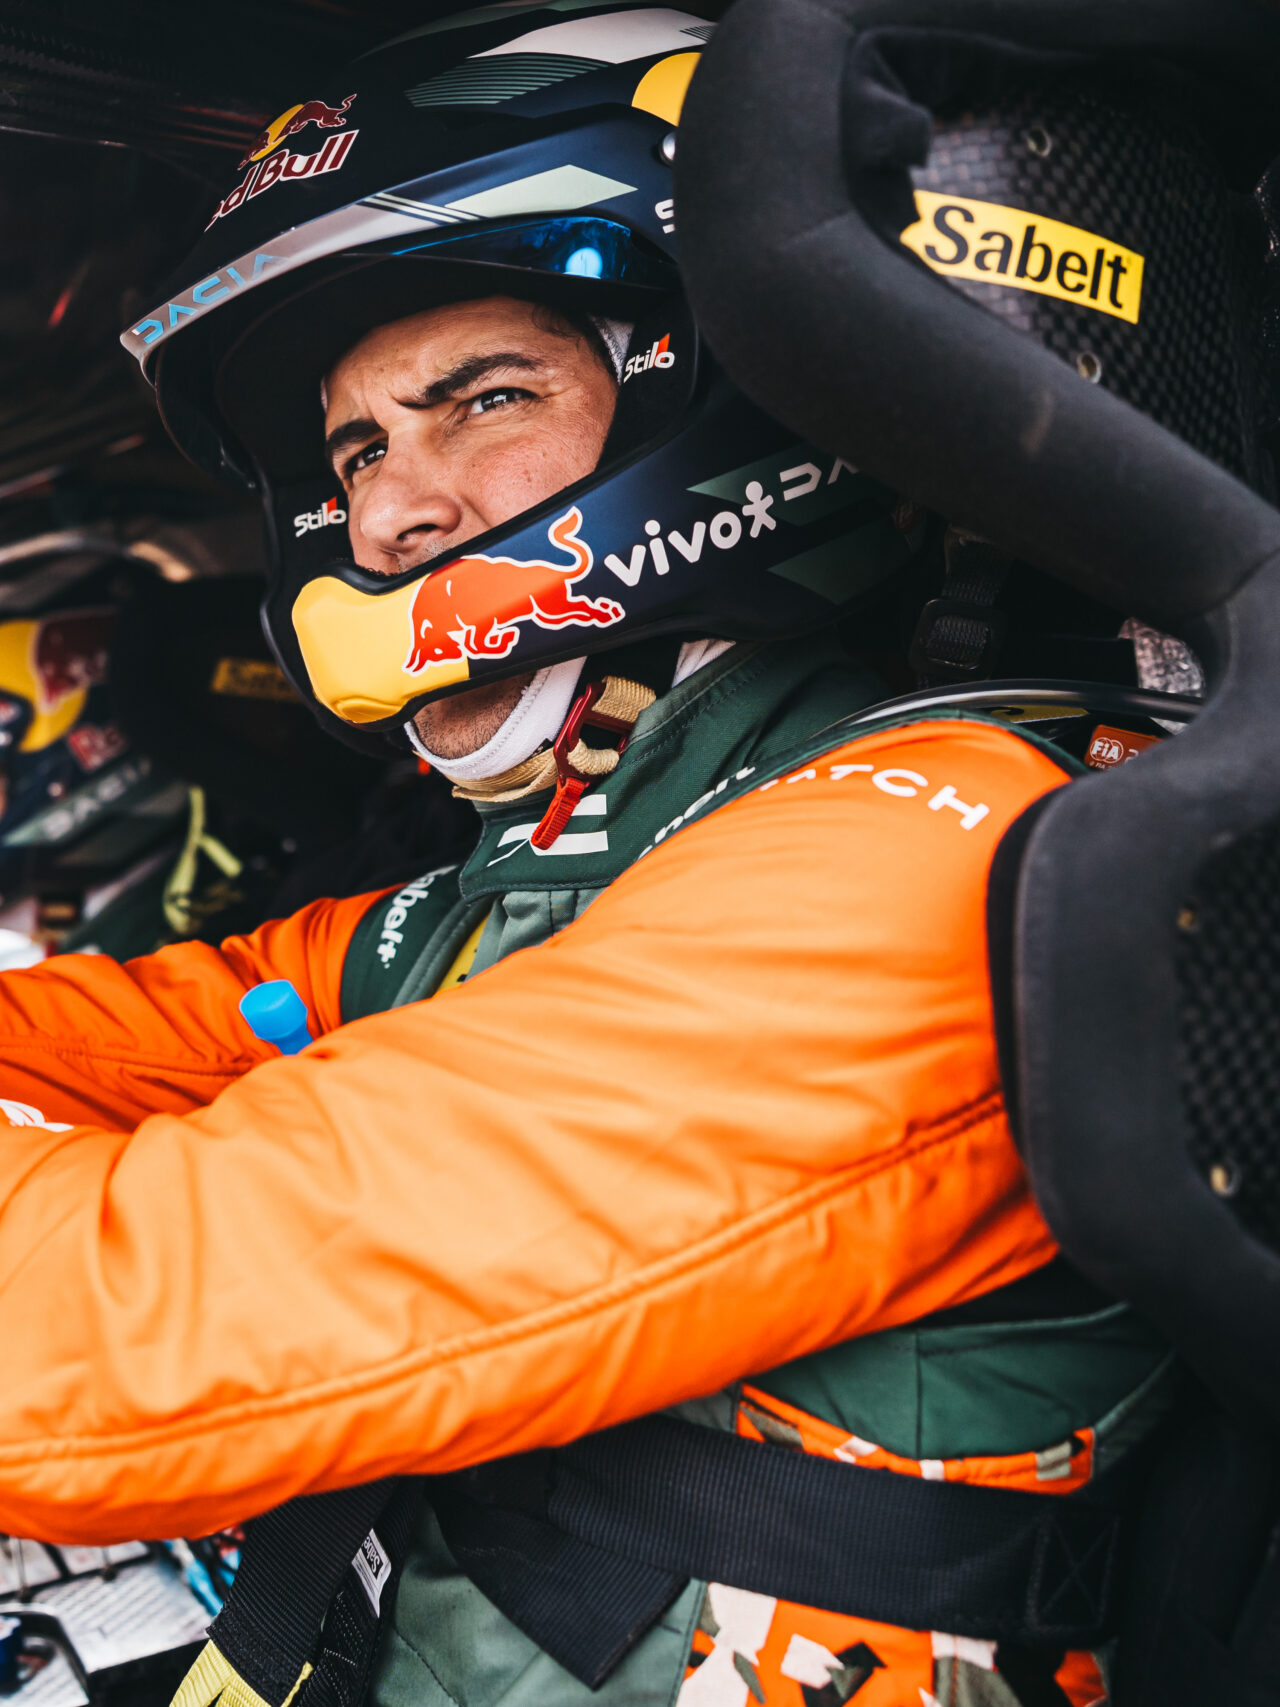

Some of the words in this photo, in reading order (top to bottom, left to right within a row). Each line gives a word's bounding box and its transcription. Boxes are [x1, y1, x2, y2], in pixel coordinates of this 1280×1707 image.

[247, 130, 360, 201] Bull
[924, 205, 1128, 309] Sabelt
[131, 253, 288, 345] DACIA
[623, 334, 675, 384] Stilo
[293, 497, 347, 538] Stilo
[604, 511, 742, 587] vivo
[361, 1535, 381, 1574] Sabe
